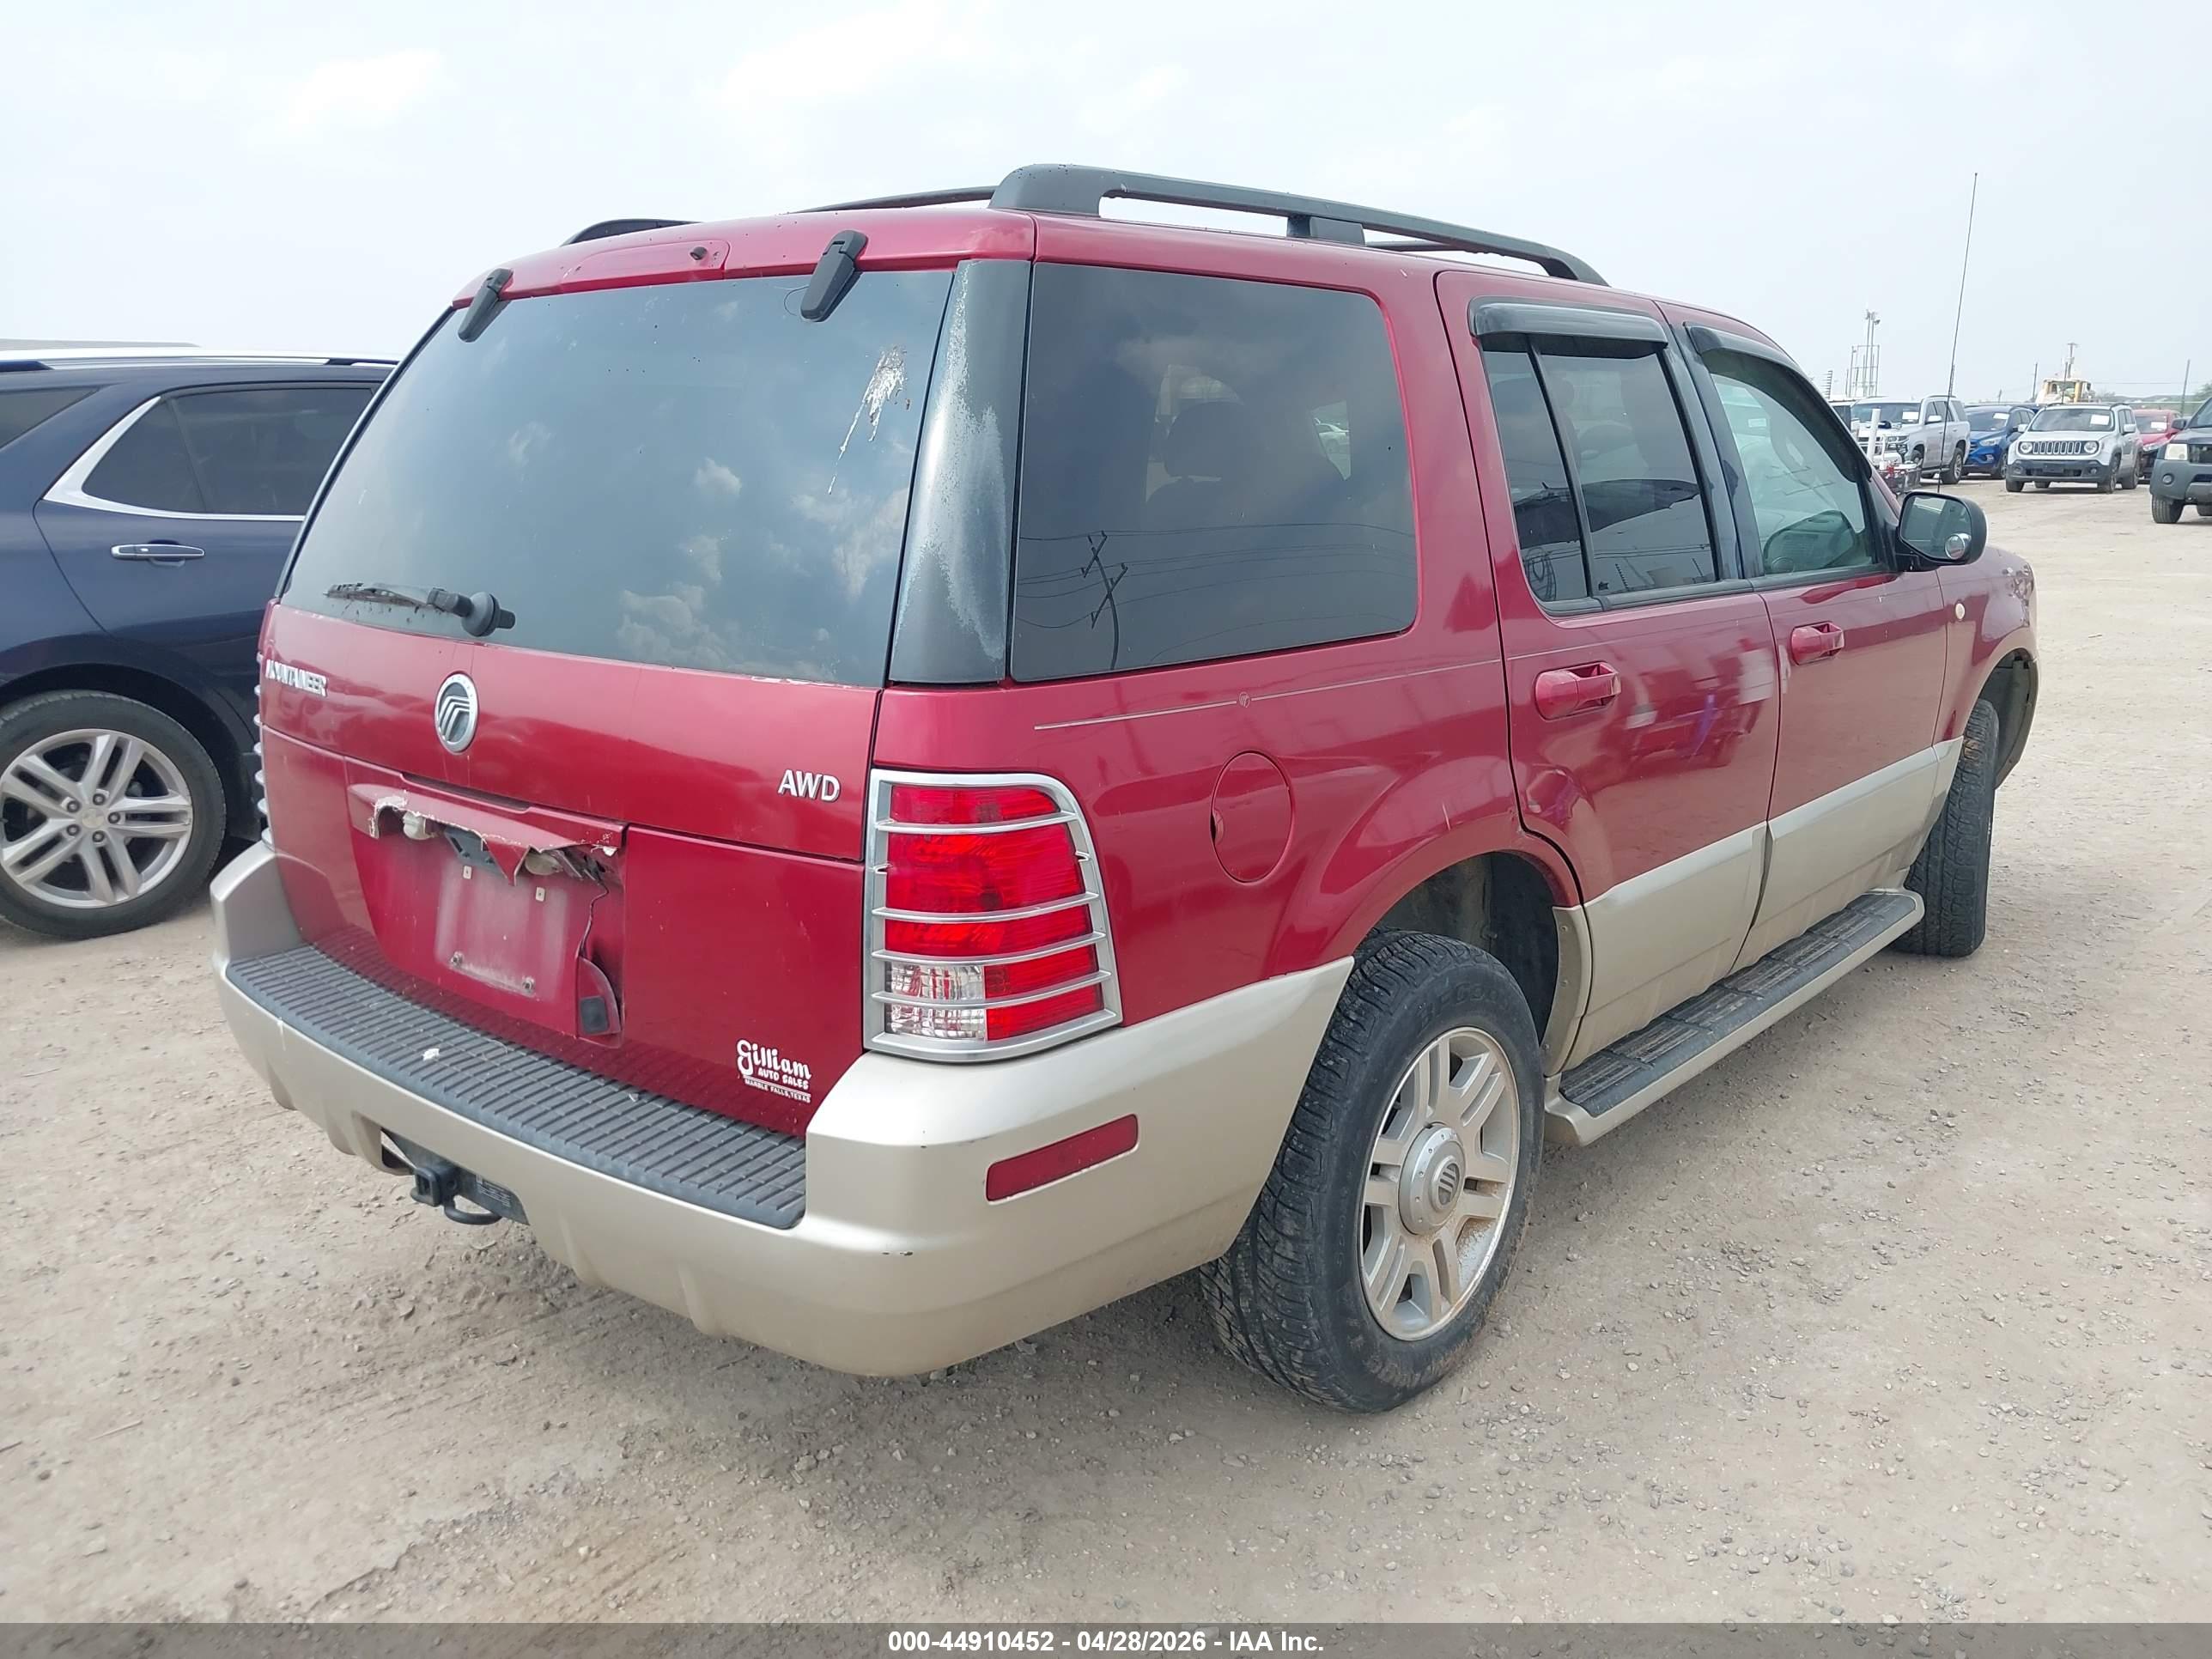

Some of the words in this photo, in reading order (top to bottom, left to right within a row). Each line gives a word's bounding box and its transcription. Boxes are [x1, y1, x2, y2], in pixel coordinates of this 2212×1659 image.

[777, 769, 841, 802] AWD
[737, 1039, 811, 1079] Gilliam
[744, 1079, 769, 1091] MARBLE
[757, 1067, 780, 1082] AUTO
[782, 1074, 809, 1090] SALES
